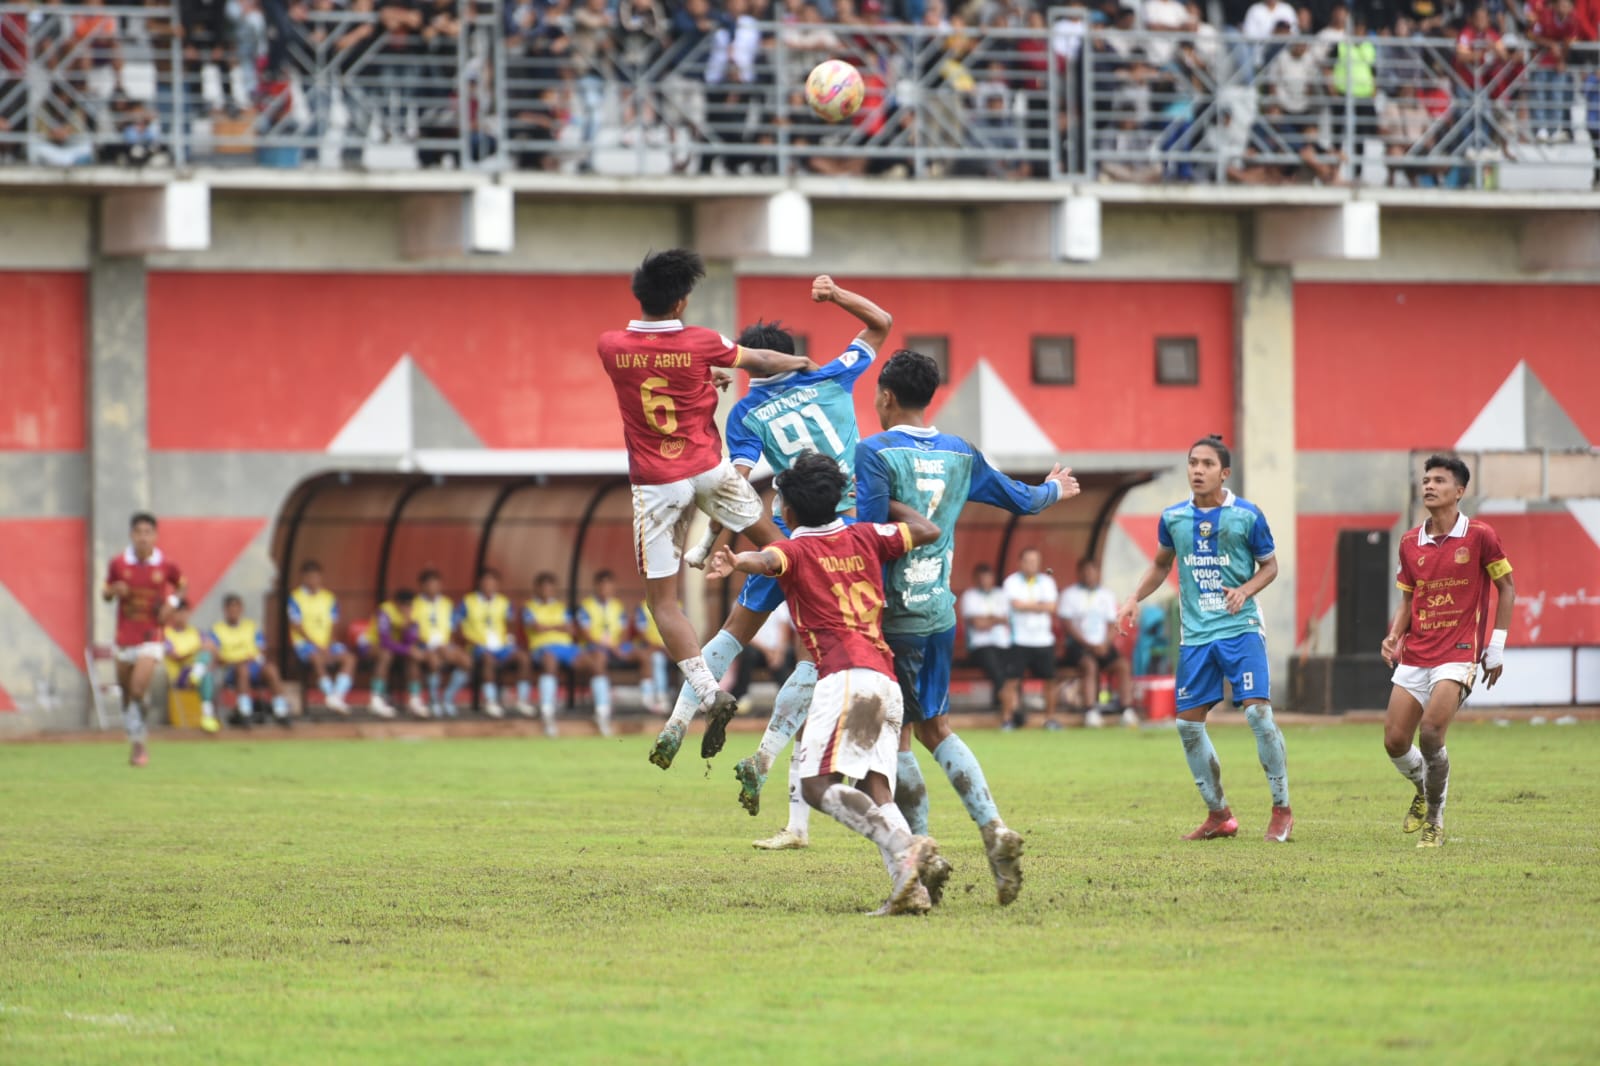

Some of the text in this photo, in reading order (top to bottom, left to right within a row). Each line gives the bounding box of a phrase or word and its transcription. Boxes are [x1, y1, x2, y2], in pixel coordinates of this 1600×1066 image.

[616, 353, 692, 368] LU'AY ABIYU
[640, 377, 678, 435] 6
[768, 403, 845, 456] 91
[916, 478, 946, 520] 7
[830, 580, 883, 638] 19
[1243, 671, 1254, 690] 9
